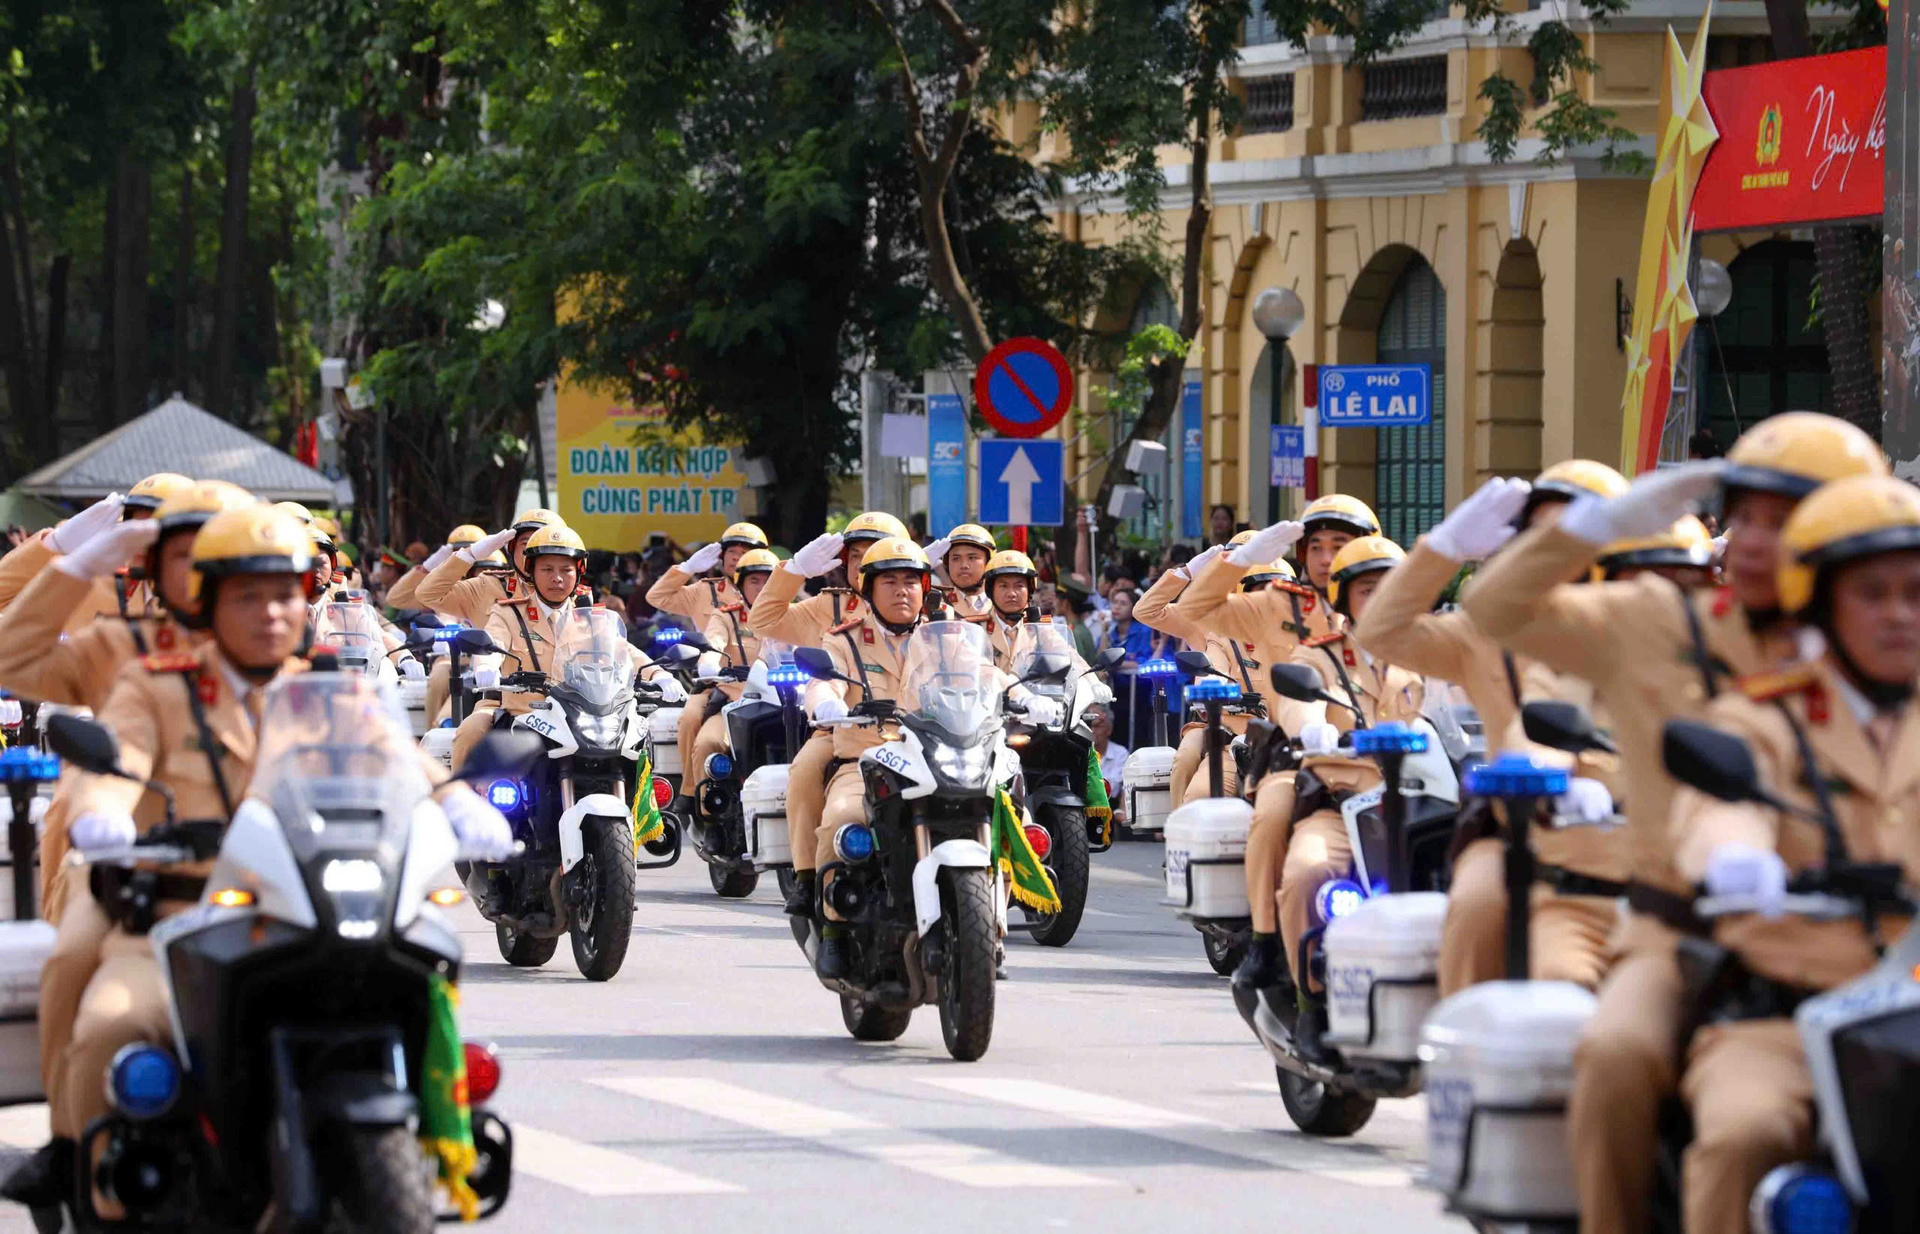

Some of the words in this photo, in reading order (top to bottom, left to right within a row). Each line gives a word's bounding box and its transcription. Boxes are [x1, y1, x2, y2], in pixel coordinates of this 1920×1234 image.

[1806, 84, 1860, 192] Ngày
[1865, 87, 1886, 159] hộ
[1366, 371, 1400, 386] PHỐ
[1330, 391, 1363, 417] LÊ
[1369, 395, 1417, 416] LAI
[571, 443, 630, 474] ĐOÀN
[687, 445, 729, 479] HỢP
[582, 482, 641, 514] CÙNG
[648, 482, 704, 514] PHÁT
[709, 488, 736, 514] TR
[525, 714, 556, 736] CSGT
[875, 748, 912, 773] CSGT
